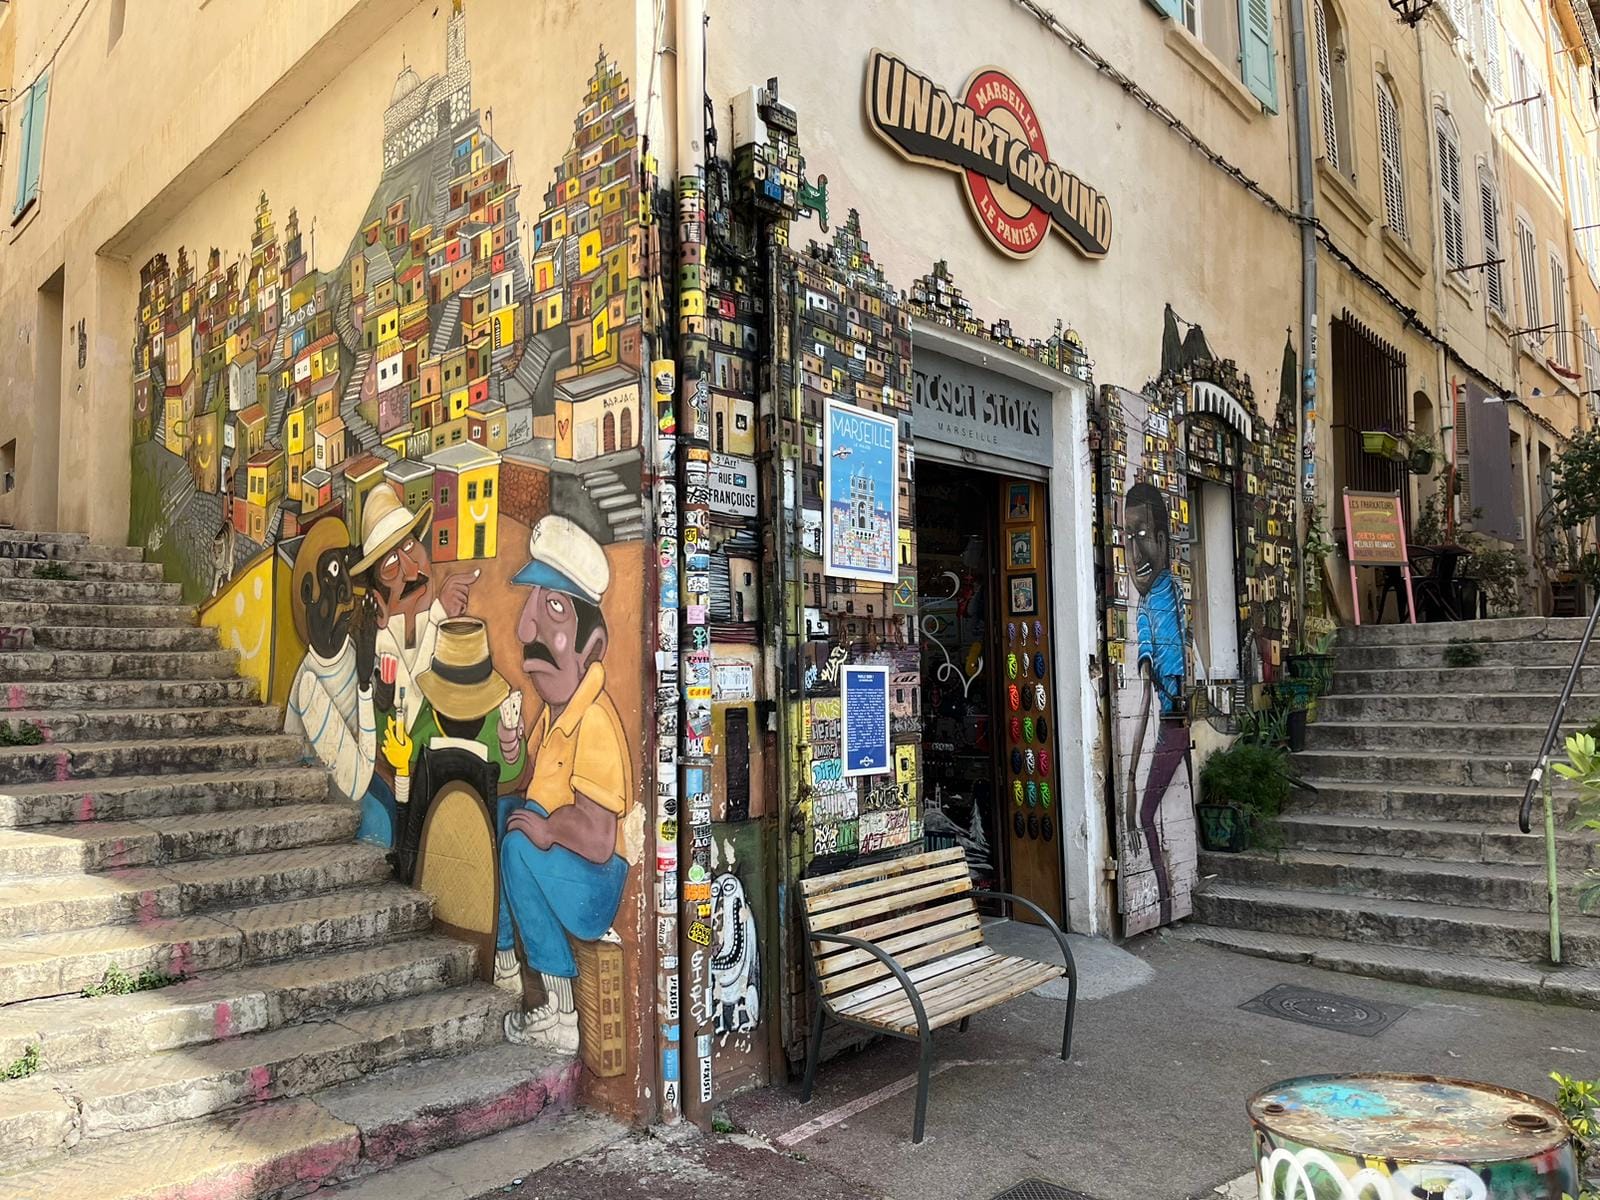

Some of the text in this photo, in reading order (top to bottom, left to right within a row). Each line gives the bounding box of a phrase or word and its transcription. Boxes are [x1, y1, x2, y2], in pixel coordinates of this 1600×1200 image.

[975, 81, 1036, 142] MARSEILLE
[872, 52, 1109, 251] UNDARTGROUND
[980, 193, 1038, 246] LE PANIER
[831, 412, 892, 450] MARSEILLE
[937, 422, 999, 445] MARSEILLE
[718, 472, 733, 485] RUE
[708, 488, 756, 509] FRANÇOISE
[669, 977, 678, 1018] J'EXISTE.
